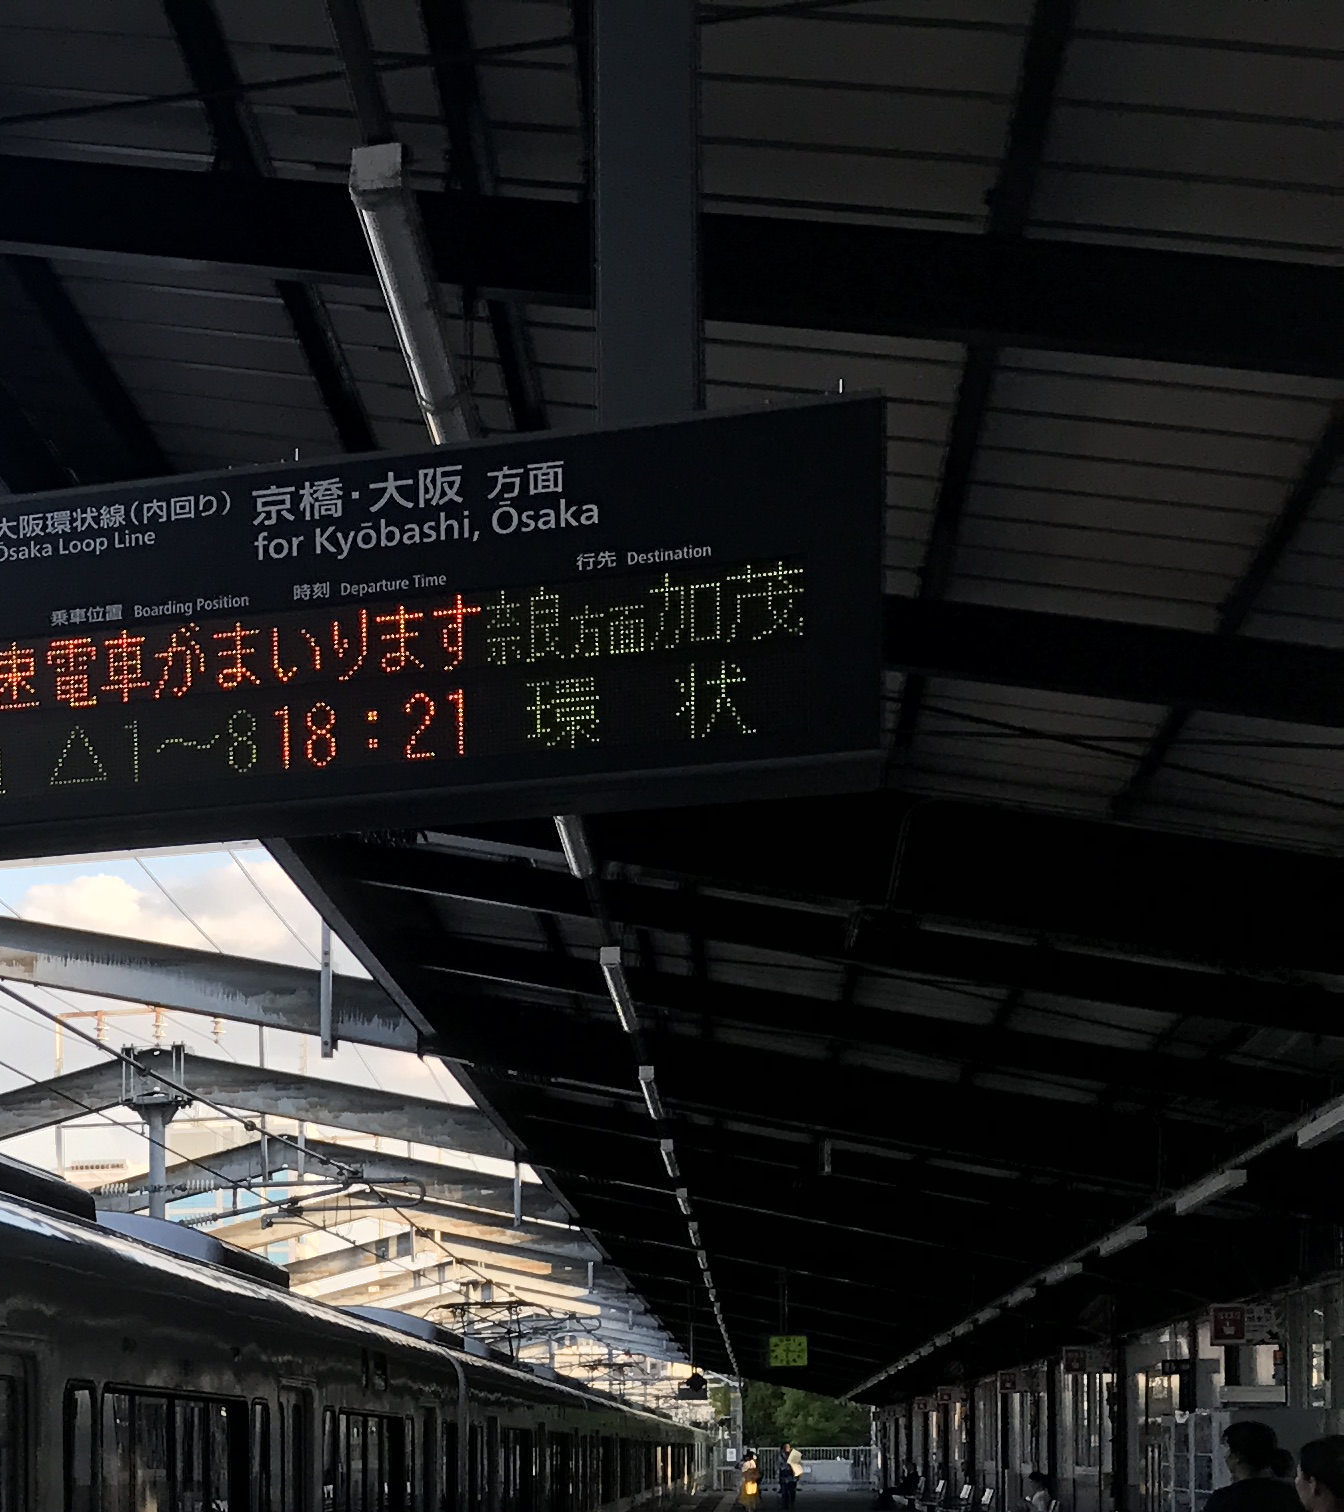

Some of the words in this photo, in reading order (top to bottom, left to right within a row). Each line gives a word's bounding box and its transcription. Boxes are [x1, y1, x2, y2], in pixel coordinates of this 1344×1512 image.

[251, 464, 464, 527] 京橋・大阪
[486, 460, 565, 500] 方面
[58, 536, 108, 558] Loop
[114, 528, 156, 548] Line
[254, 530, 304, 561] for
[314, 510, 480, 559] Kyōbashi,
[492, 500, 600, 535] Ōsaka
[576, 551, 617, 571] 行先
[627, 543, 712, 565] Destination
[292, 583, 330, 601] 時刻
[340, 576, 409, 597] Departure
[413, 572, 447, 587] Time
[50, 603, 123, 627] 乗車位置
[134, 600, 193, 622] Boarding
[196, 594, 250, 611] Position
[273, 687, 466, 770] 18:21
